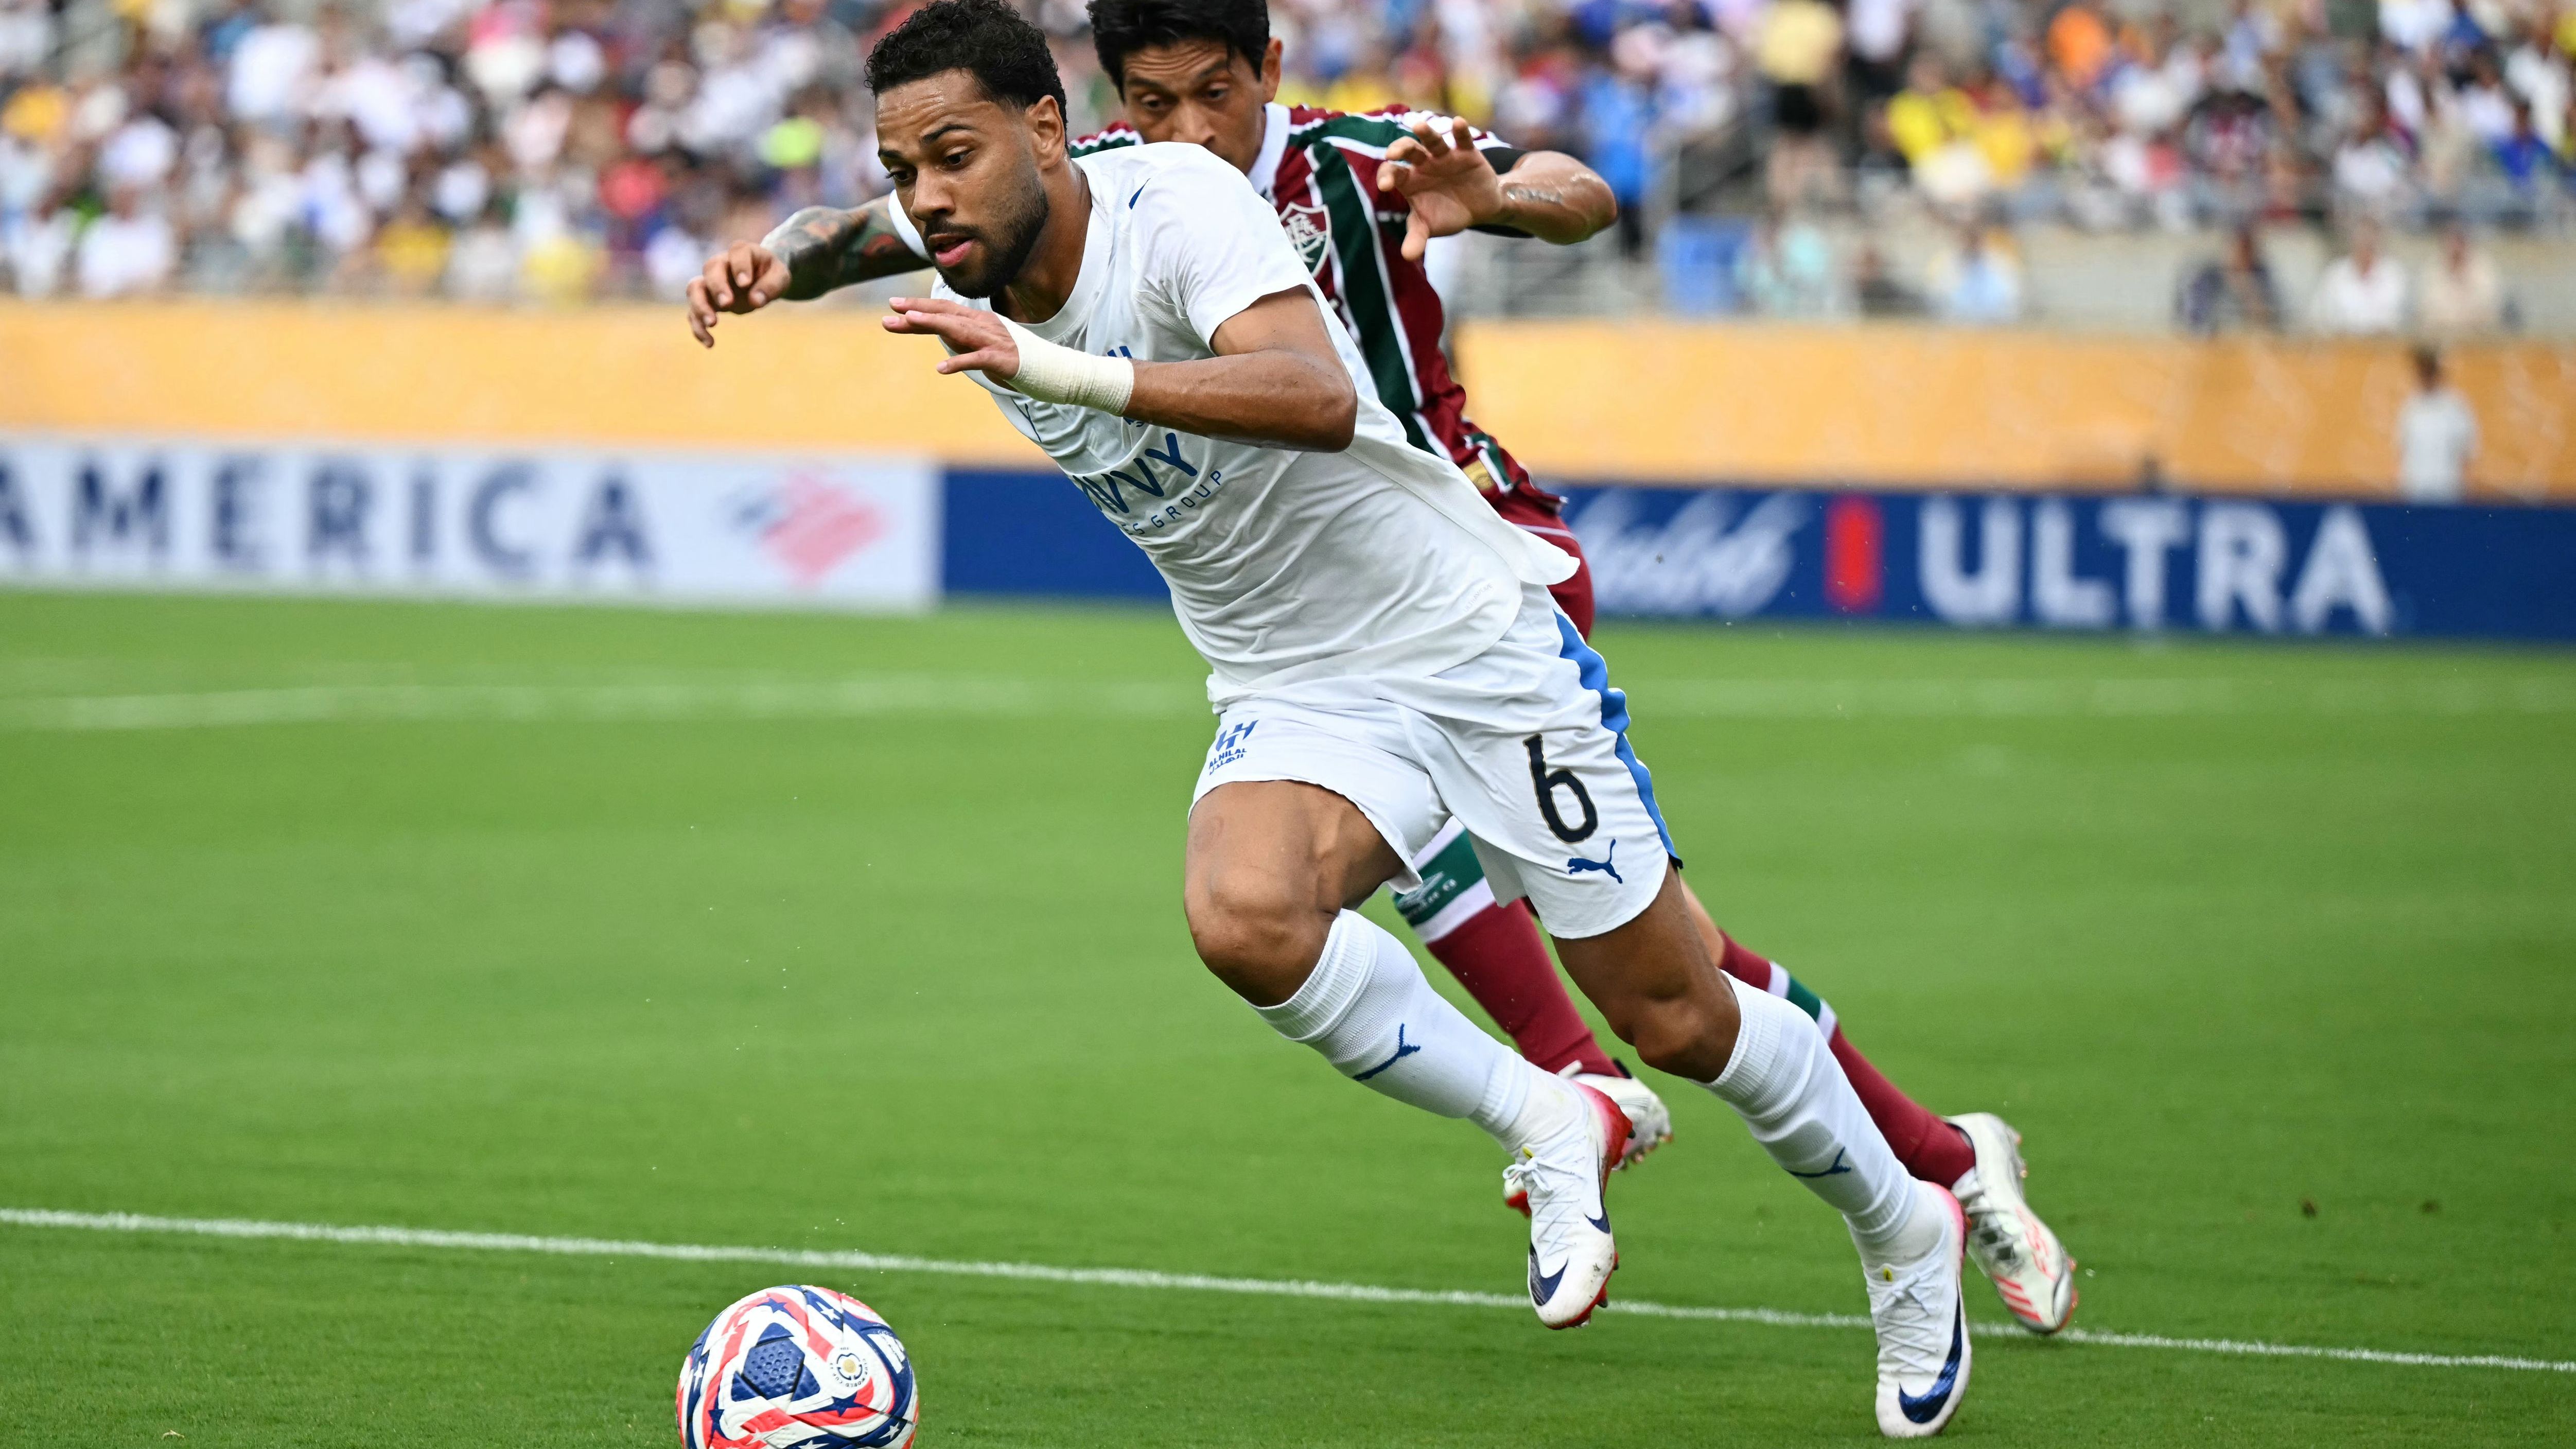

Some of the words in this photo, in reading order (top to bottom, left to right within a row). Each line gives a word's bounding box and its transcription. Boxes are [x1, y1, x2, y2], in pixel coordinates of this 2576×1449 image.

[1151, 470, 1223, 528] GROUP
[1917, 496, 2394, 632] ULTRA
[1209, 758, 1218, 770] AL
[1219, 748, 1247, 761] HILAL
[1523, 733, 1599, 845] 6
